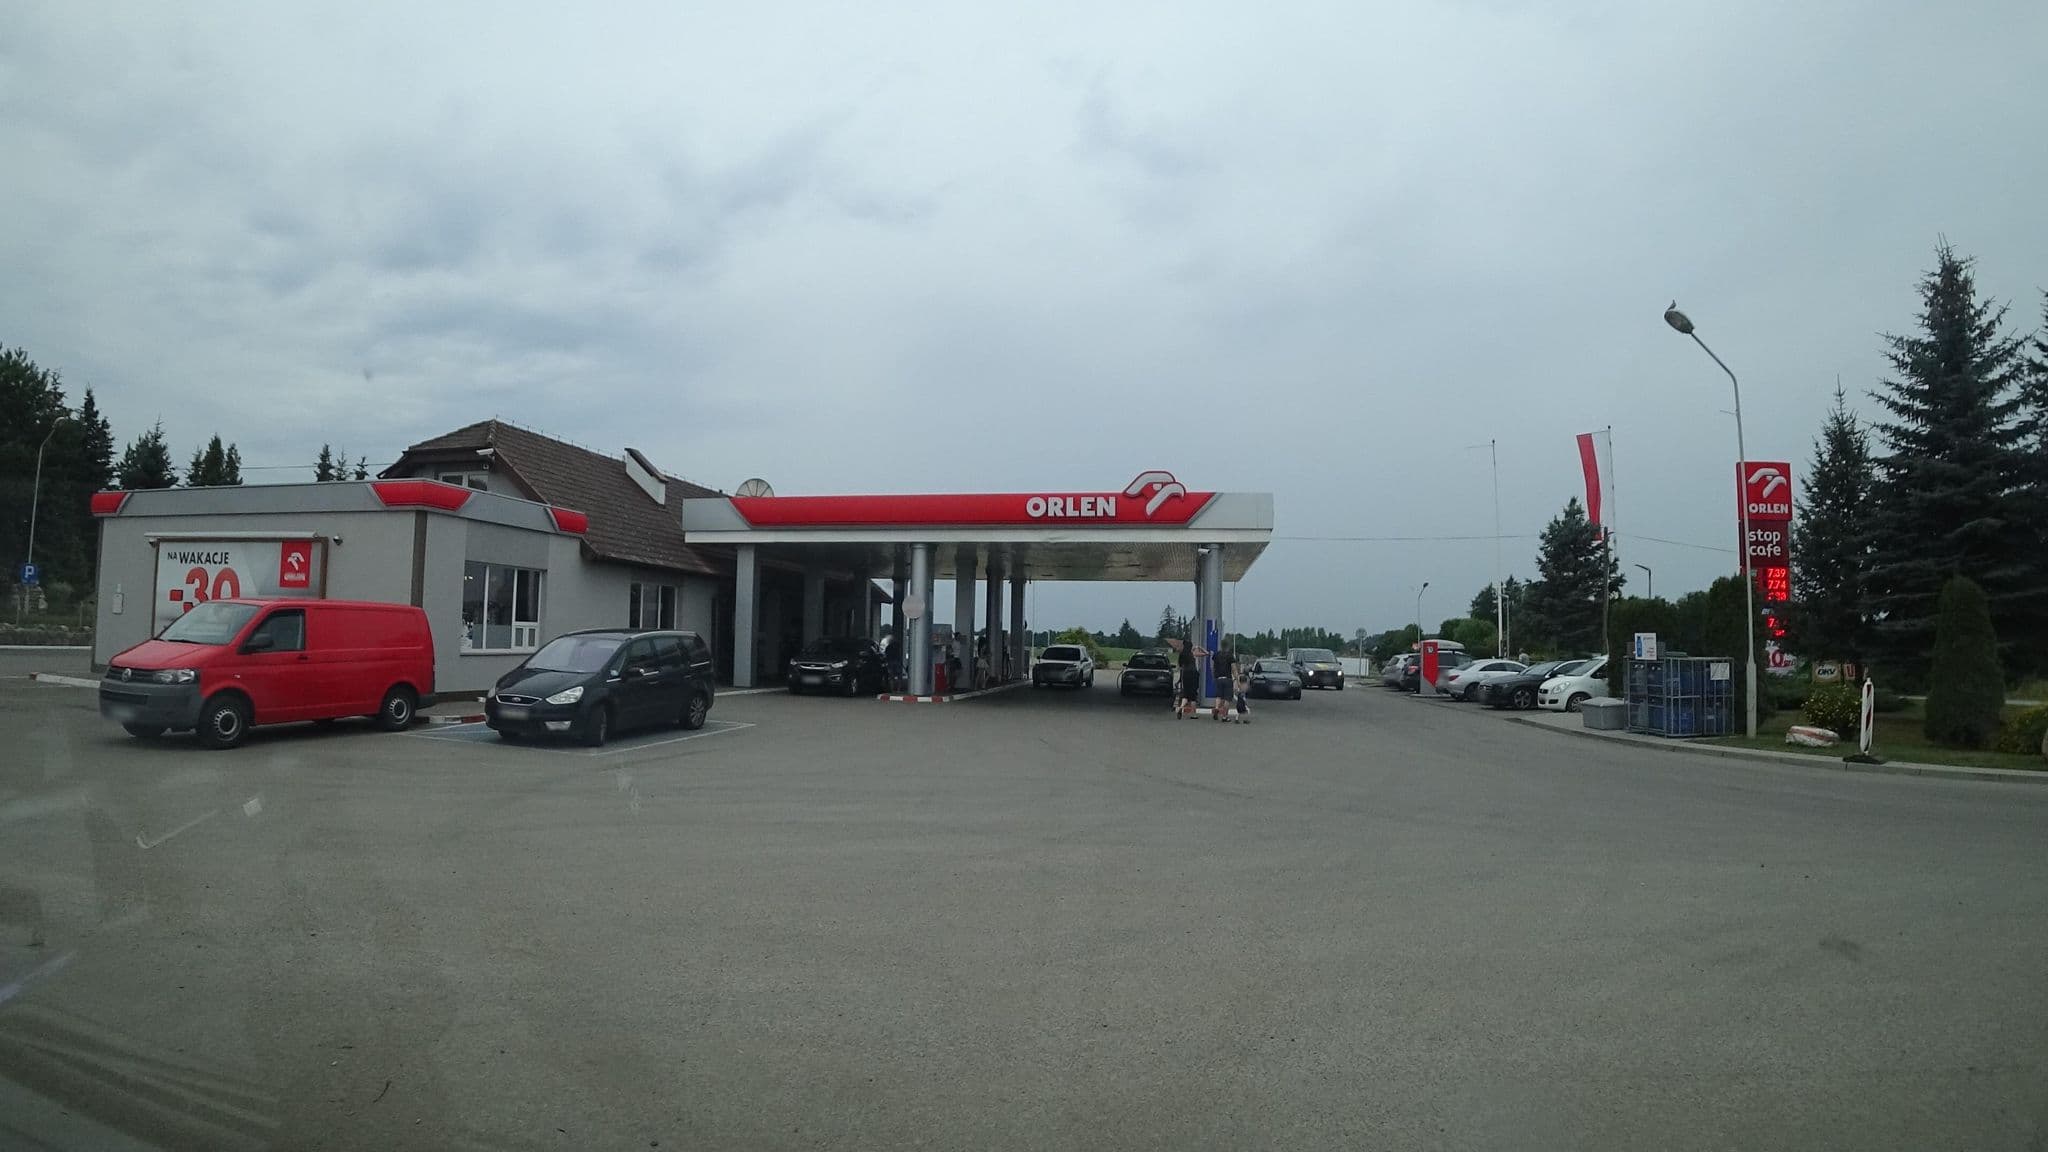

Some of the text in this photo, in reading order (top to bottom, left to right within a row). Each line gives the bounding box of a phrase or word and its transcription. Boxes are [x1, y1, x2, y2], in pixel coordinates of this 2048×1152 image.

[1026, 496, 1116, 517] ORLEN
[1749, 503, 1788, 514] ORLEN
[1749, 529, 1781, 545] stop
[1749, 544, 1781, 556] cafe
[168, 552, 229, 564] NA WAKACJE
[24, 565, 34, 578] P
